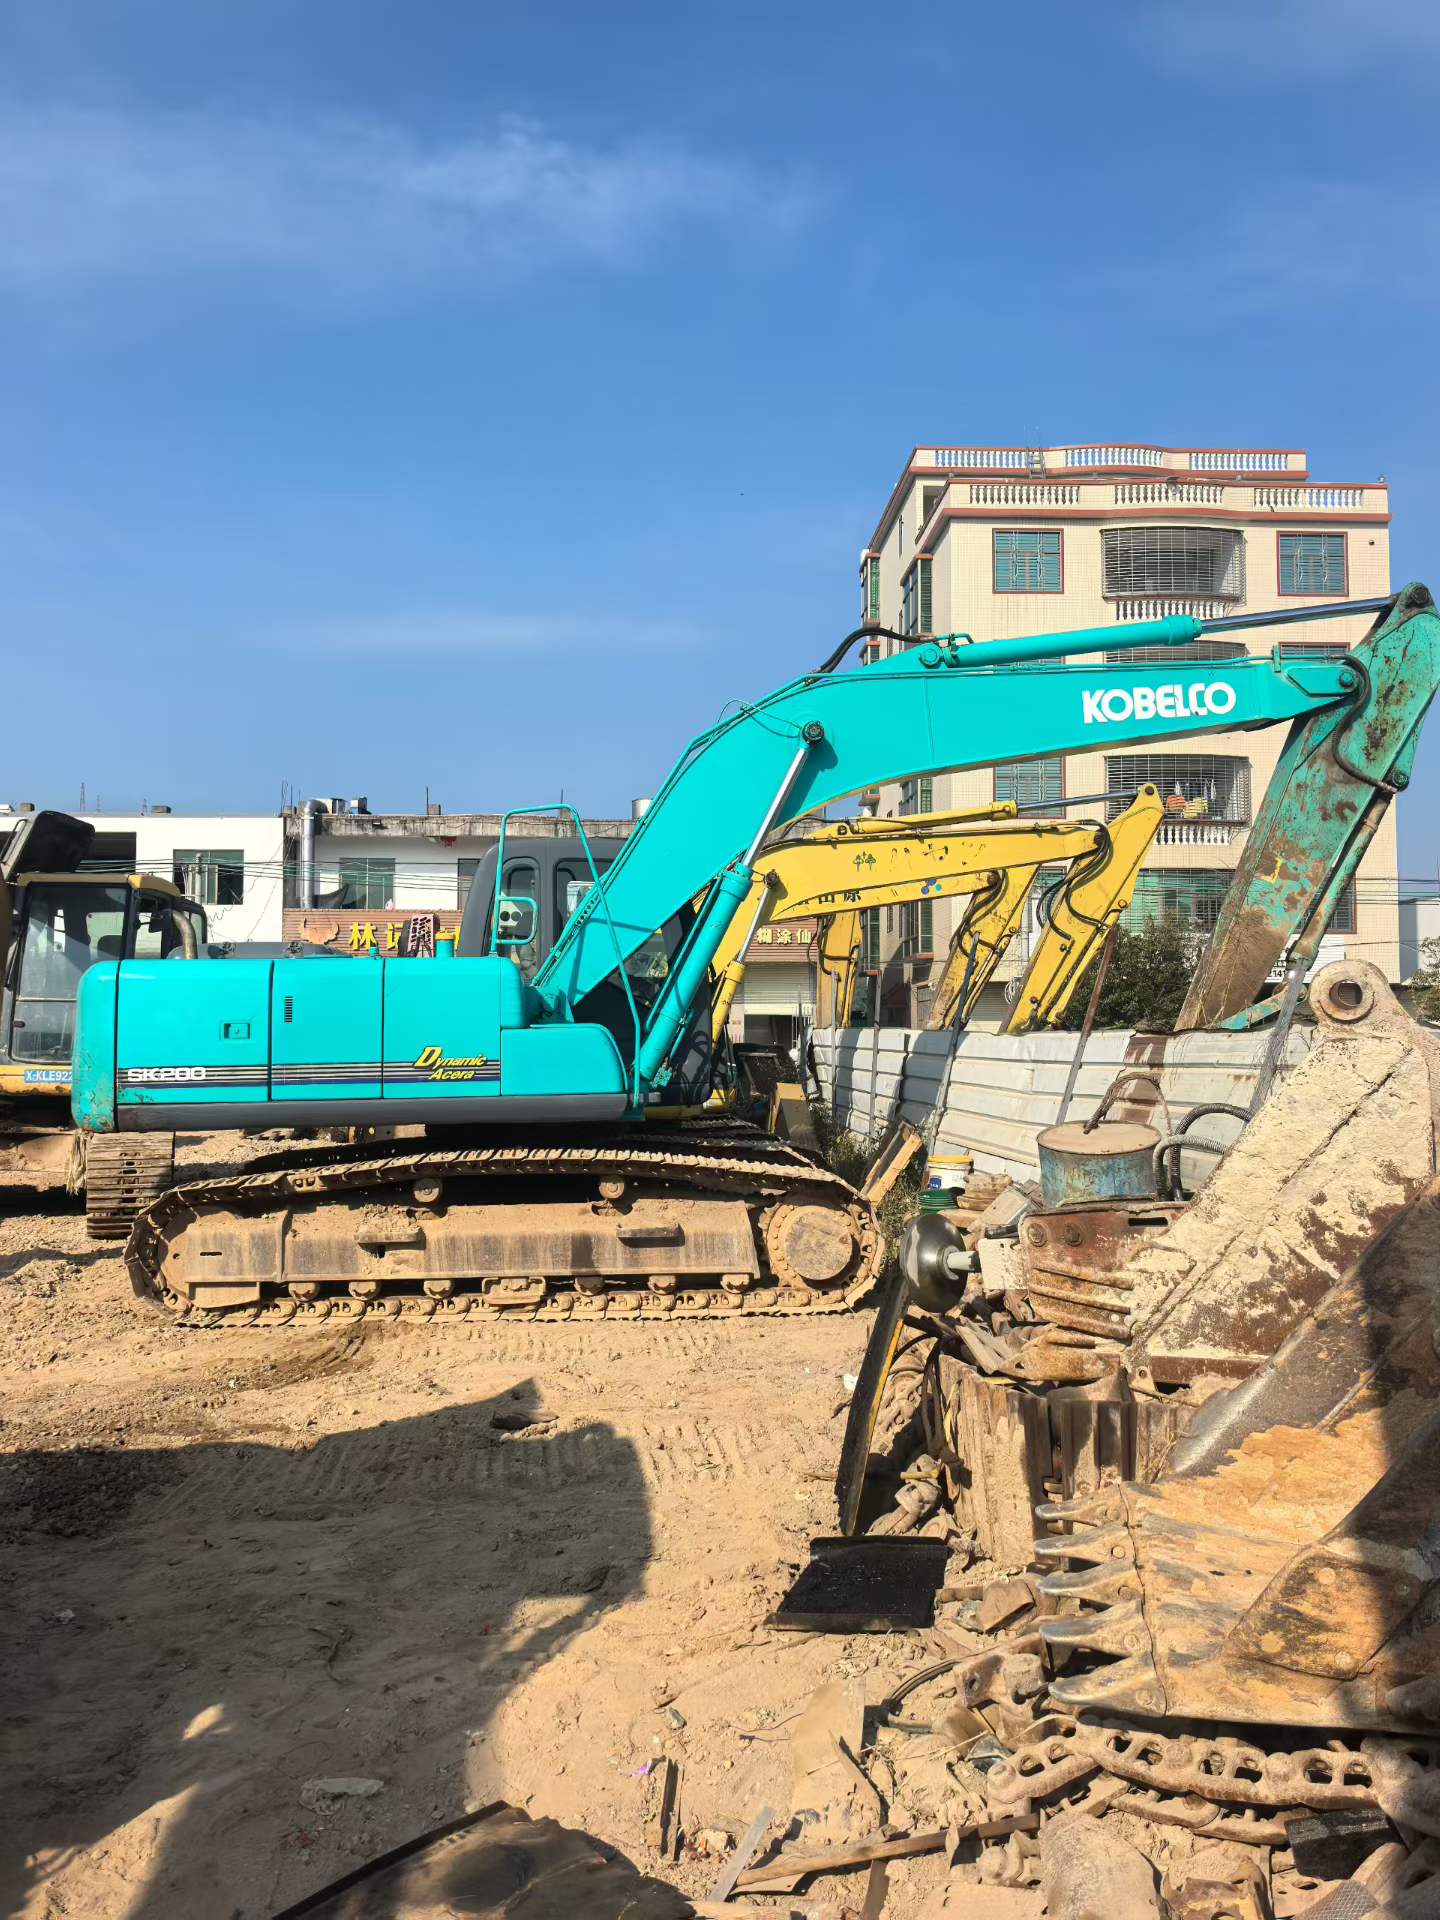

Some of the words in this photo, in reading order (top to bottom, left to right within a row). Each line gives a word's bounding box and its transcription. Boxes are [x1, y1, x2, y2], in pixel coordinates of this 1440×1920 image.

[1082, 681, 1237, 724] KOBELCO
[414, 1046, 487, 1070] Dynamic
[428, 1068, 476, 1080] Acera
